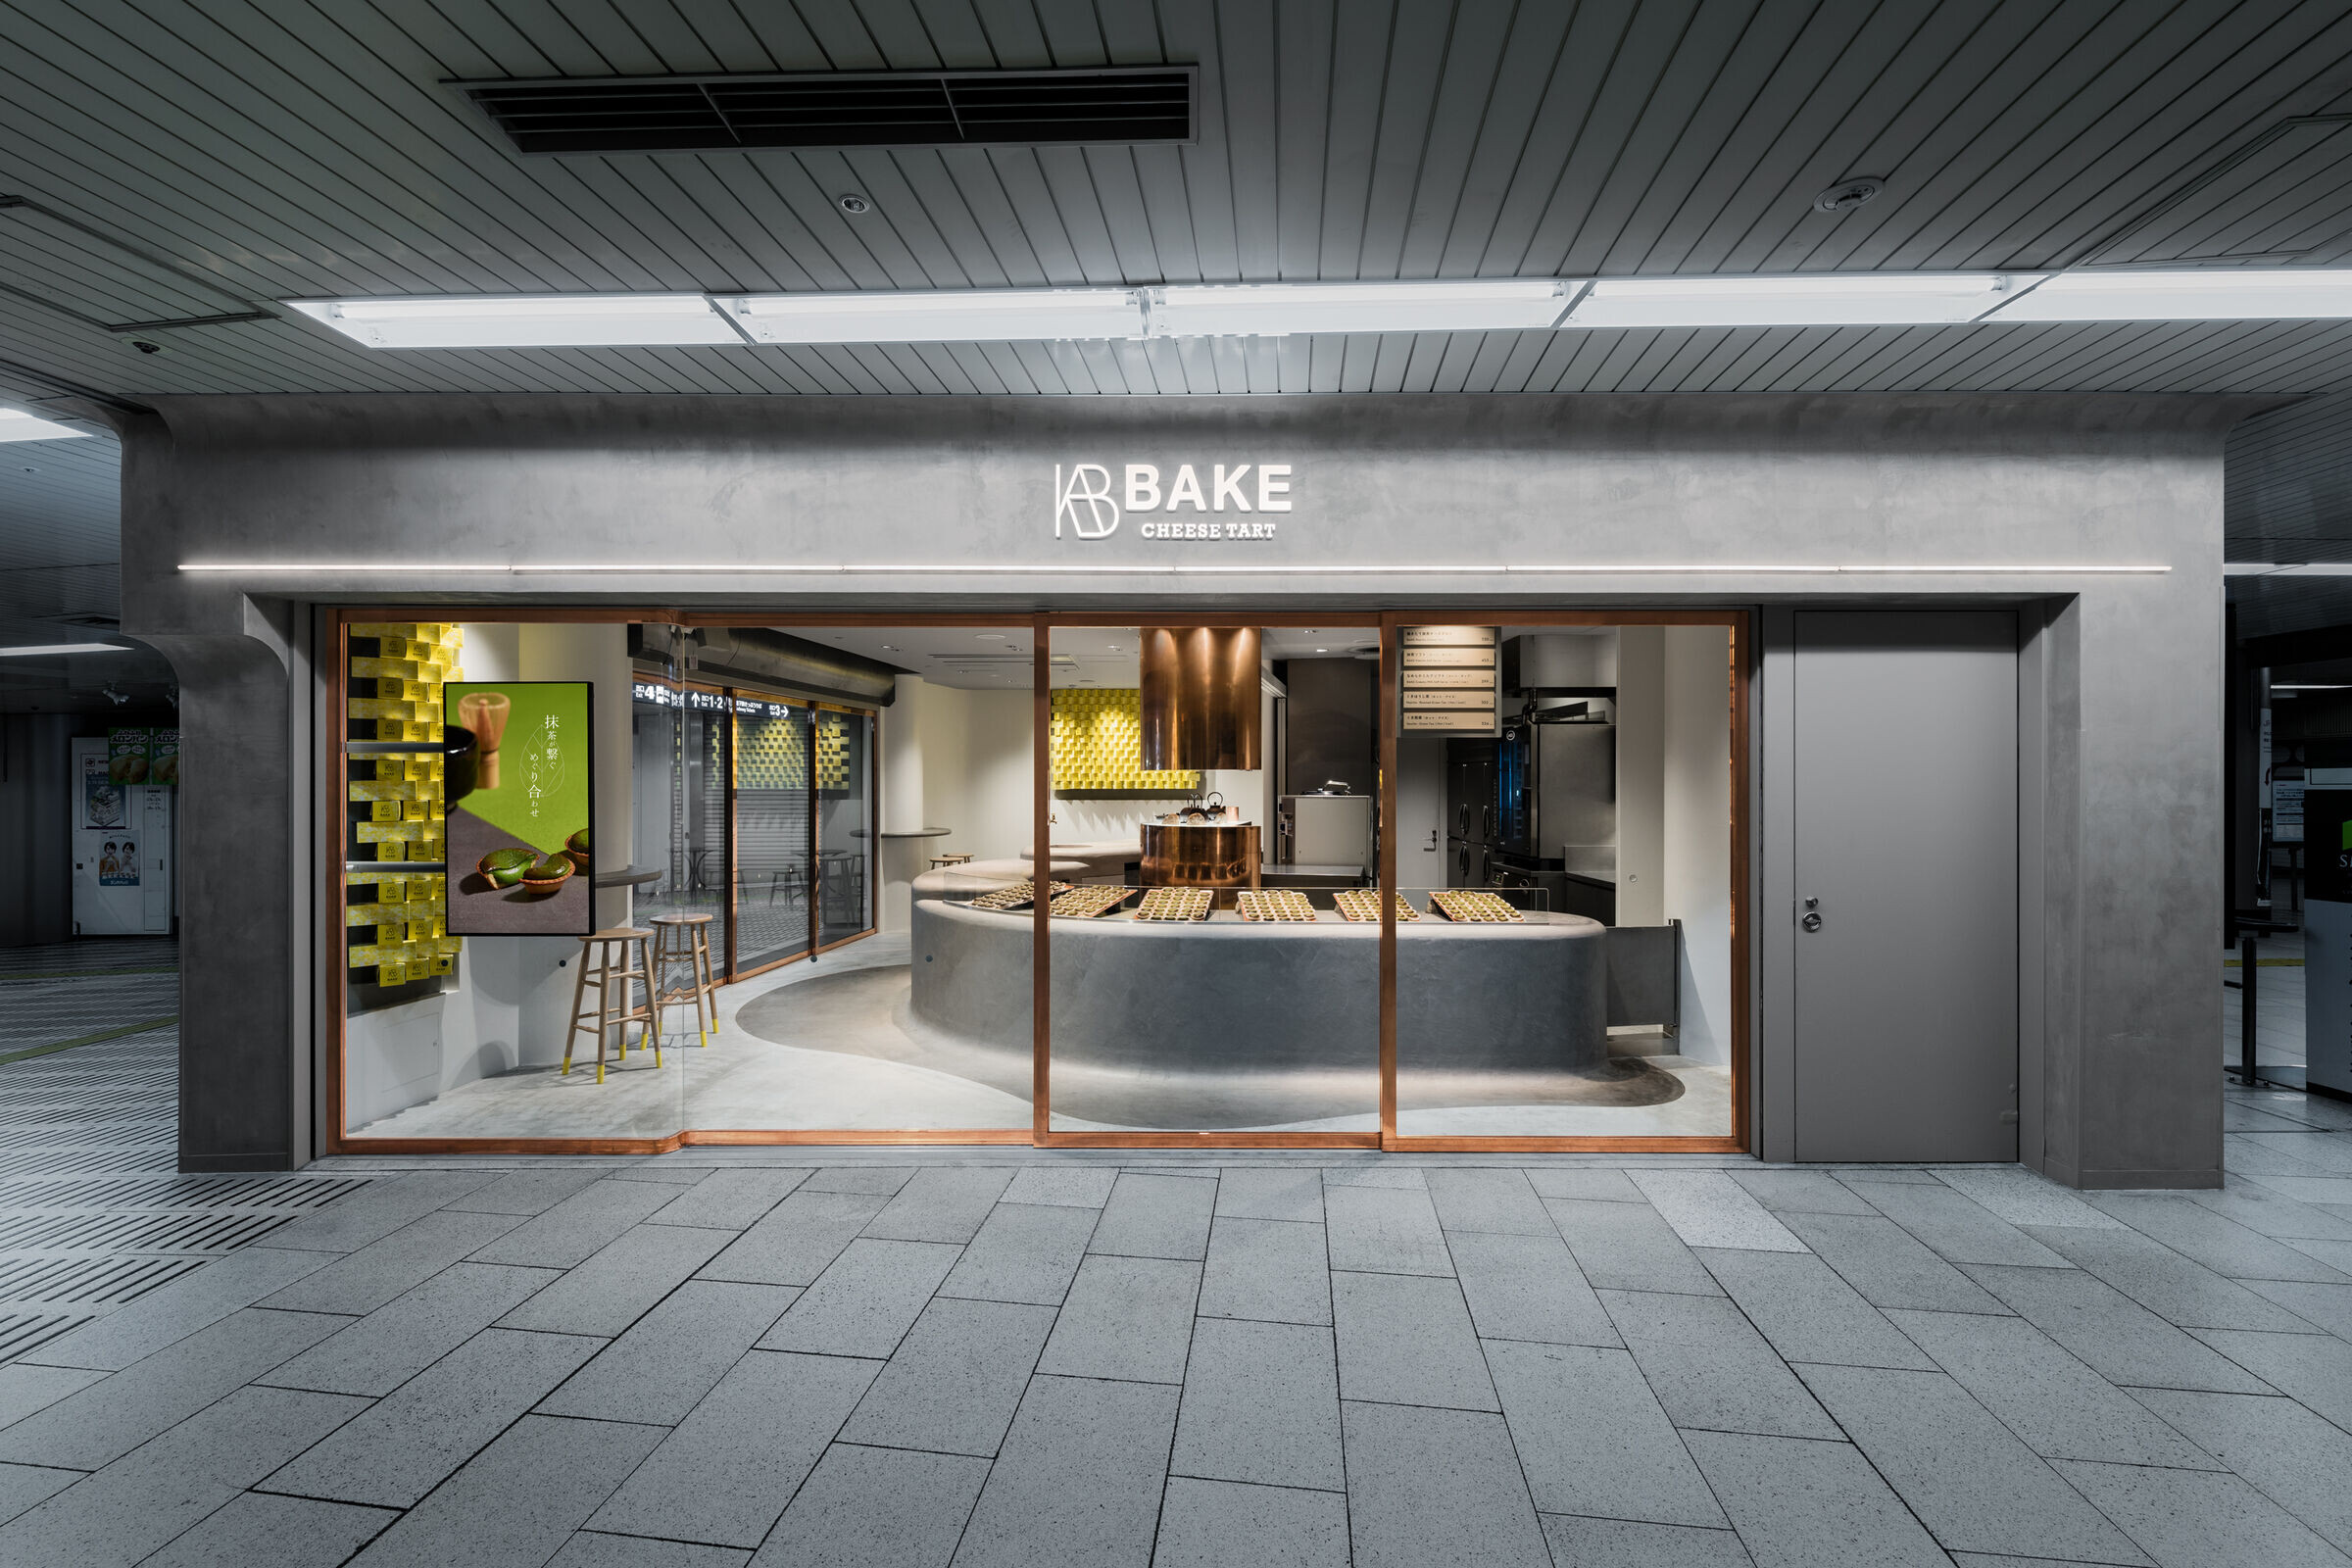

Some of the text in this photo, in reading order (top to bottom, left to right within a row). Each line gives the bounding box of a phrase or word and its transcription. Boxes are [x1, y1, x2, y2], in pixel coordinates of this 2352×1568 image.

[1125, 465, 1292, 512] BAKE
[1142, 522, 1275, 538] CHEESE TART
[644, 685, 655, 700] 4
[775, 705, 781, 716] 3
[110, 735, 148, 744] メロンパン
[155, 735, 179, 744] メロン
[528, 753, 542, 817] めぐり合わせ
